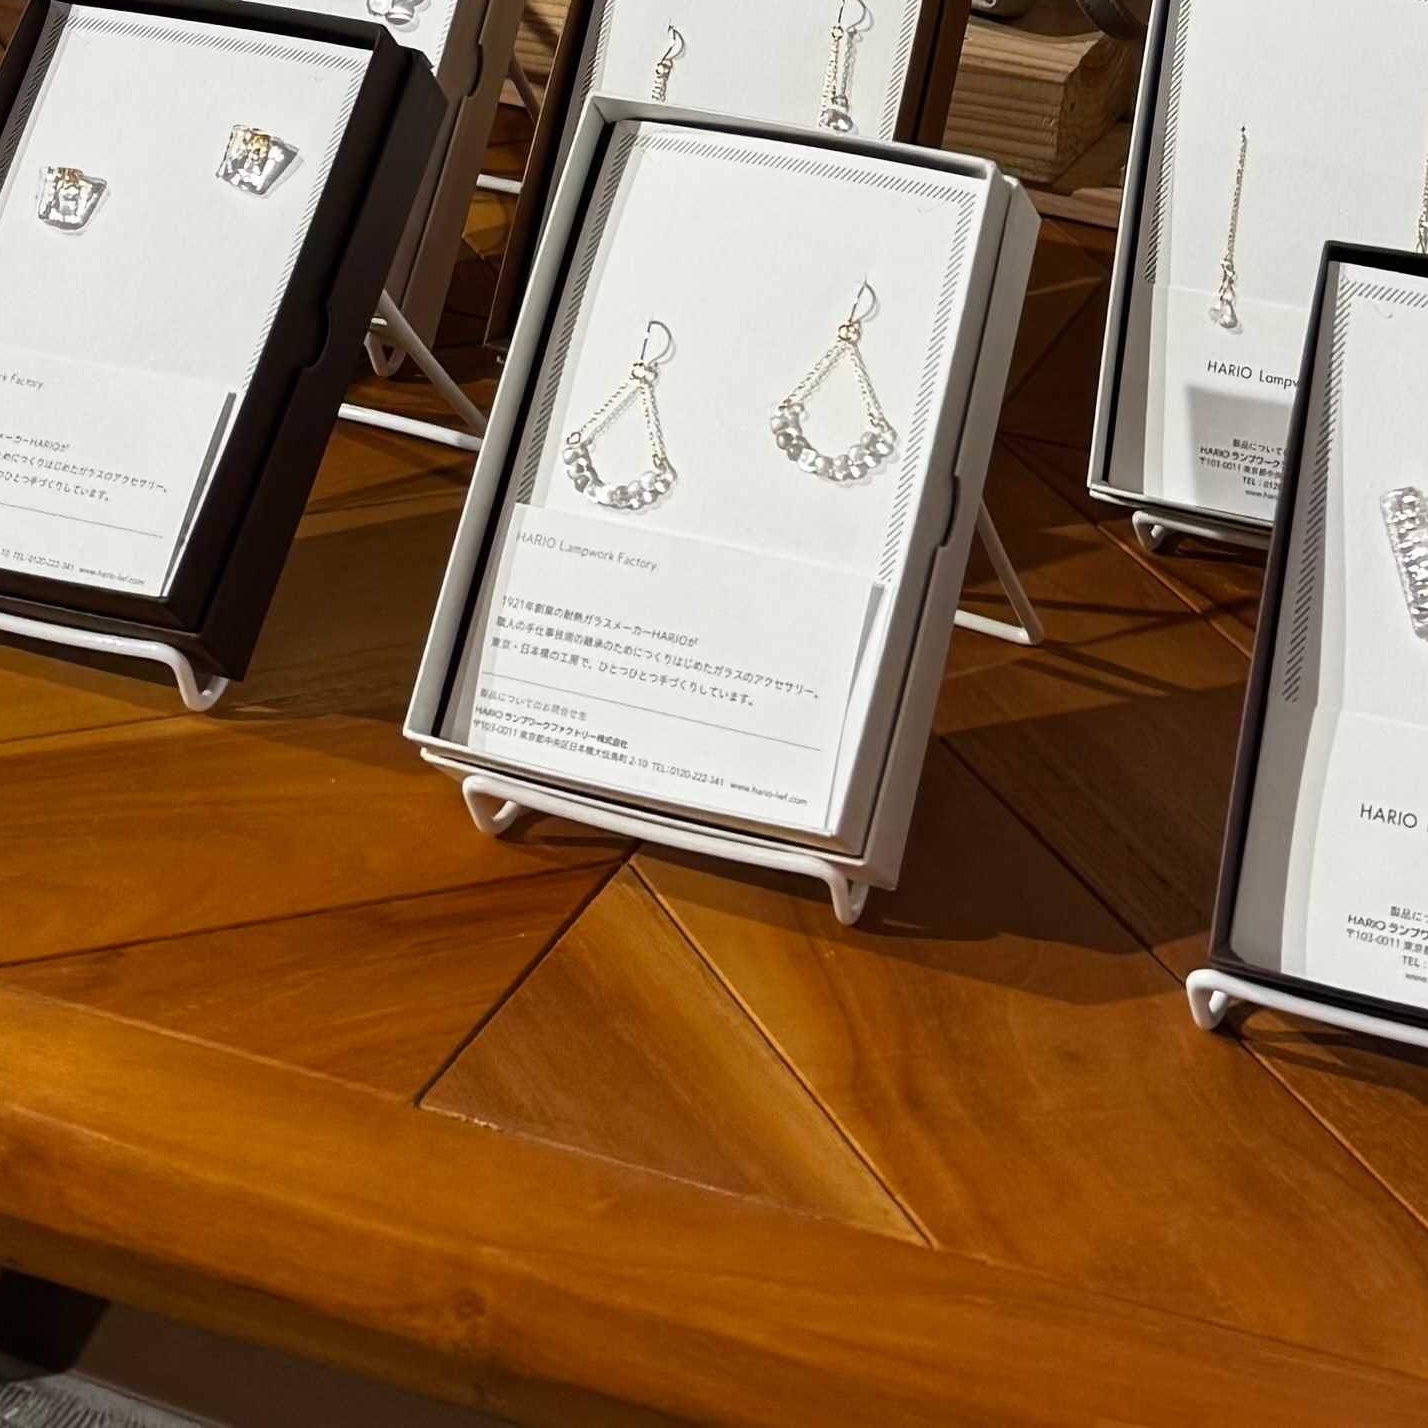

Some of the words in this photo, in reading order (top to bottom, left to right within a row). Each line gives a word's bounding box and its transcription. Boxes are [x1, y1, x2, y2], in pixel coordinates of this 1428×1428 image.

[1207, 360, 1253, 380] HARIO
[1232, 438, 1287, 456] 製品について
[1232, 451, 1285, 468] ランプワーク
[515, 531, 557, 550] HARIO
[559, 539, 615, 563] Lampwork
[617, 551, 657, 573] Factory
[1359, 803, 1418, 829] HARIO
[1347, 914, 1386, 931] HARIO
